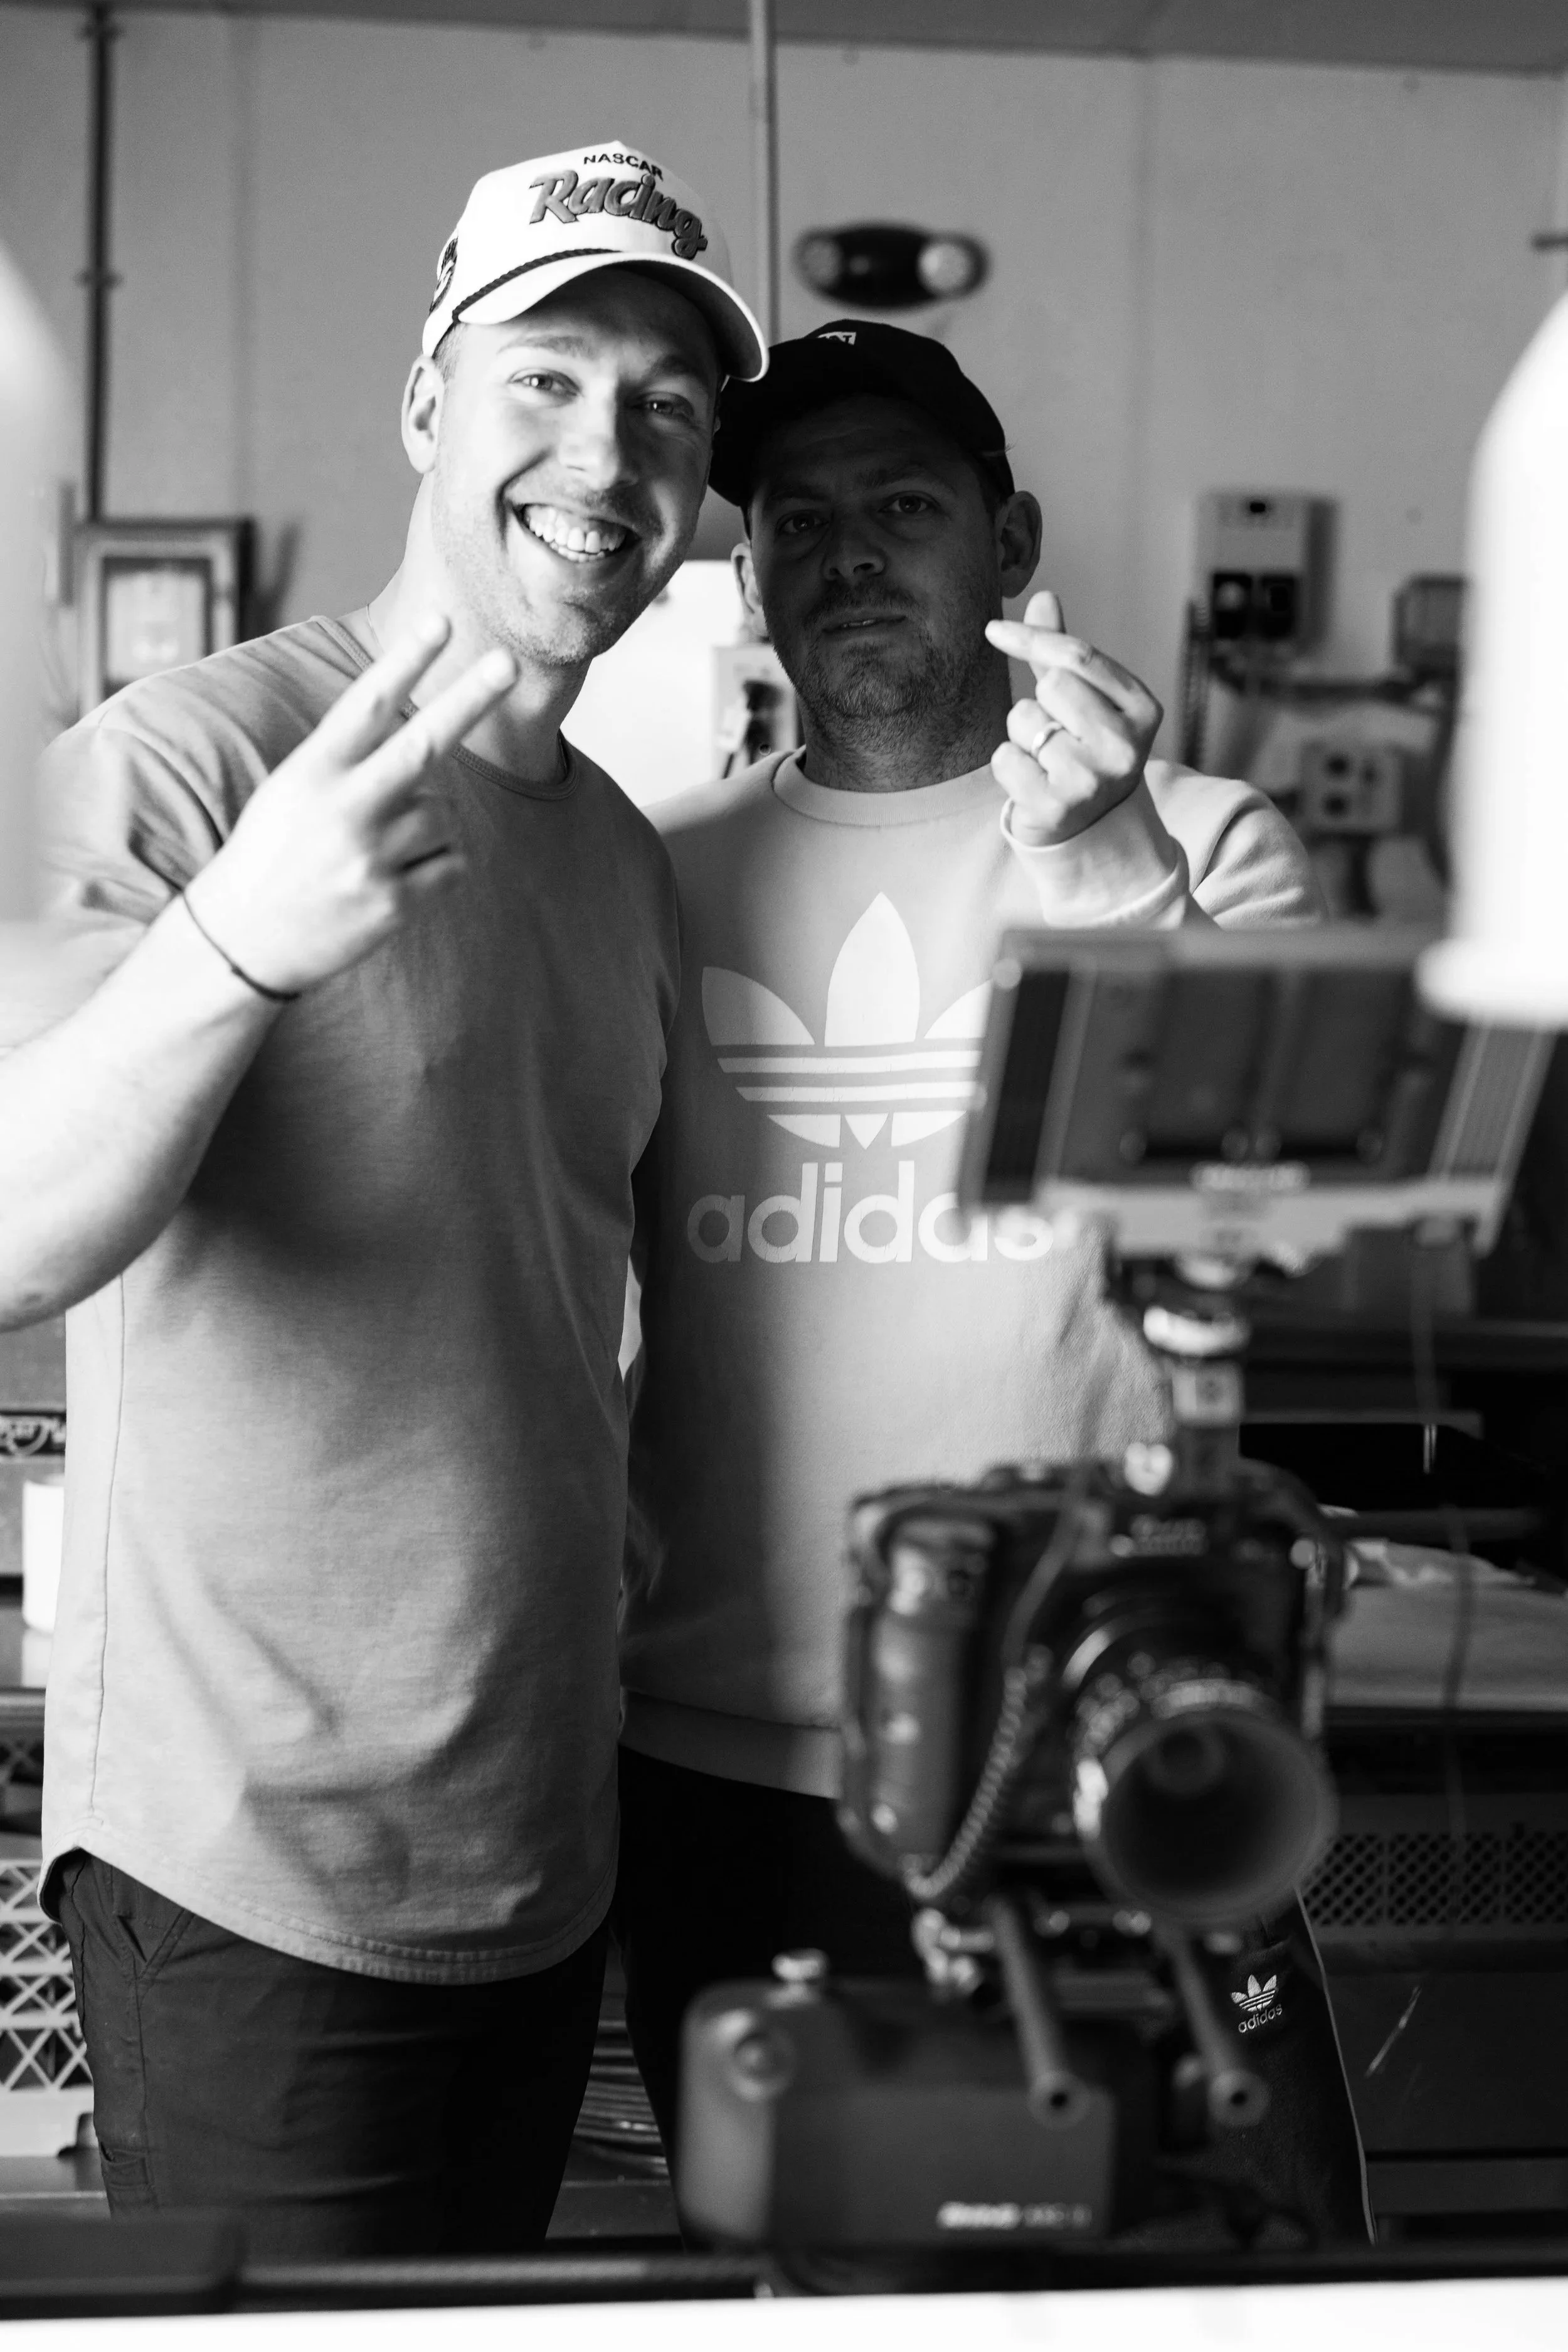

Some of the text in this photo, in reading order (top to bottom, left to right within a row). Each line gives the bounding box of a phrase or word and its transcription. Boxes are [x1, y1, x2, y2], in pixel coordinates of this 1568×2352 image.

[583, 152, 664, 182] NASCAR
[529, 169, 709, 261] Racing
[1238, 2004, 1283, 2033] adidas
